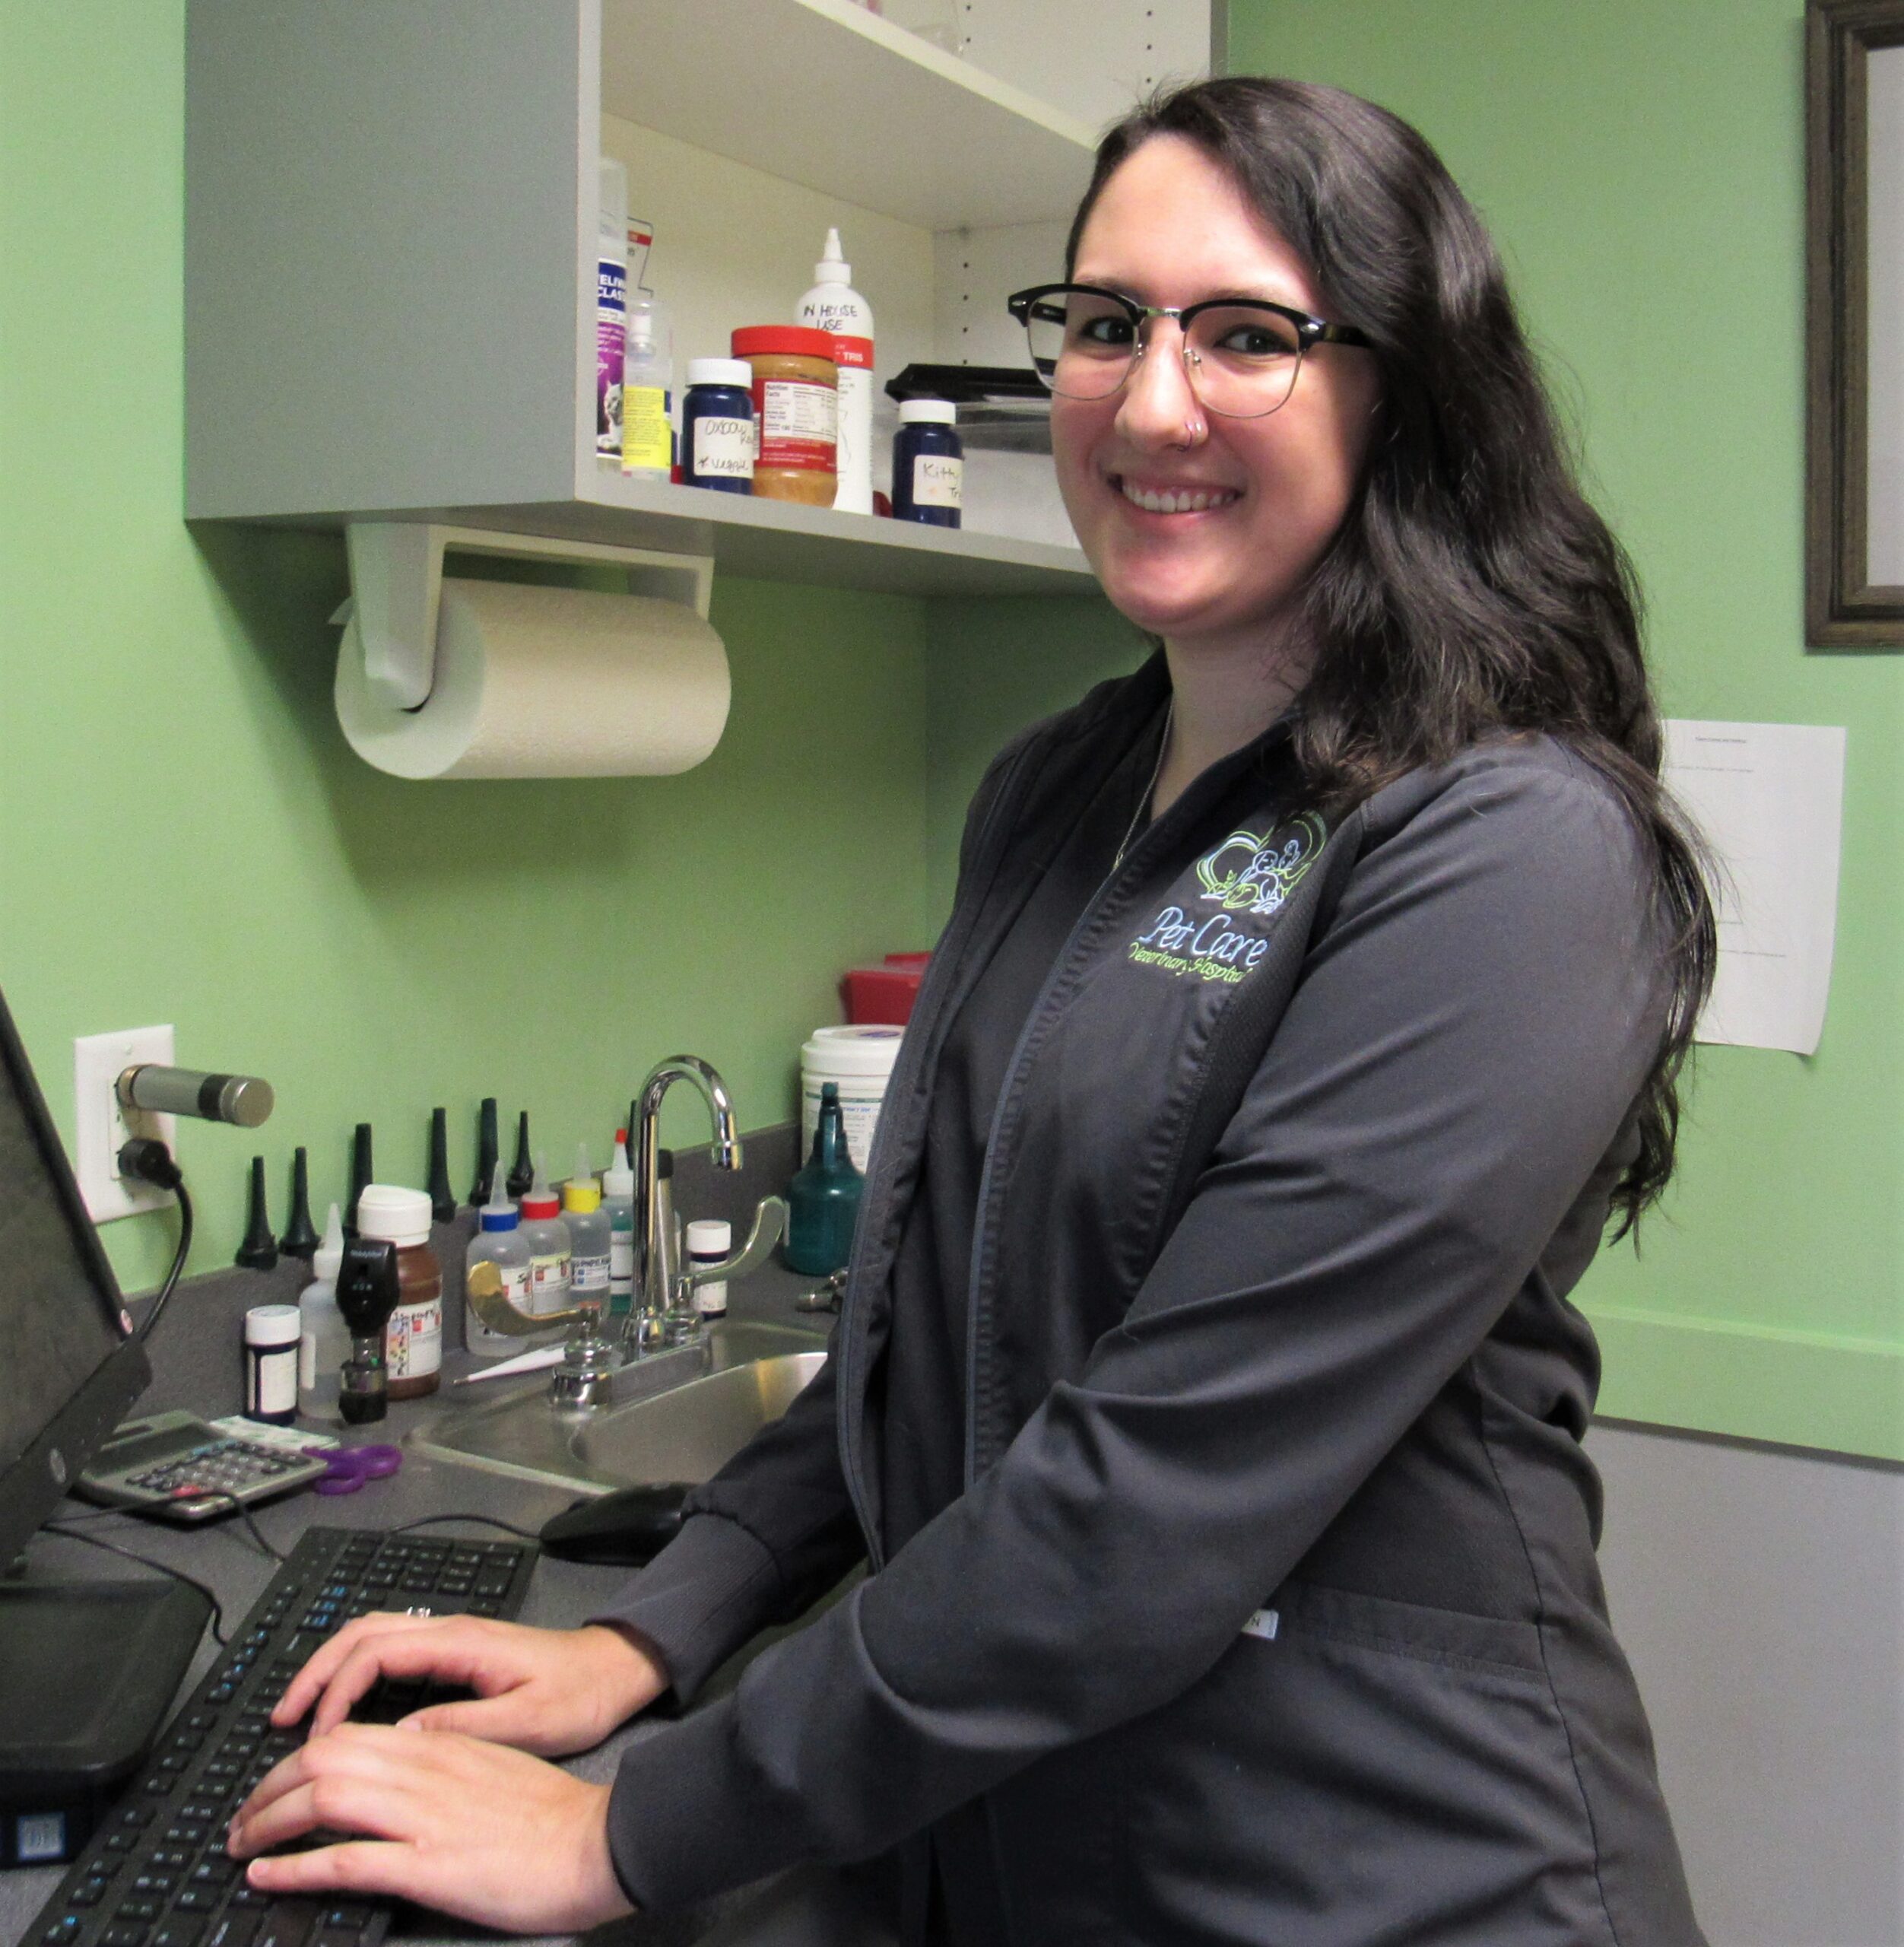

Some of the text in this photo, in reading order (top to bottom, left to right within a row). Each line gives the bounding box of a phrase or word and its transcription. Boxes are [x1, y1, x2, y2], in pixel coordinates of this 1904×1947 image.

[820, 304, 858, 317] HOUSE
[816, 319, 843, 331] USE
[1137, 906, 1268, 967] Pet Care
[1128, 942, 1253, 983] Veterinary Hospital
